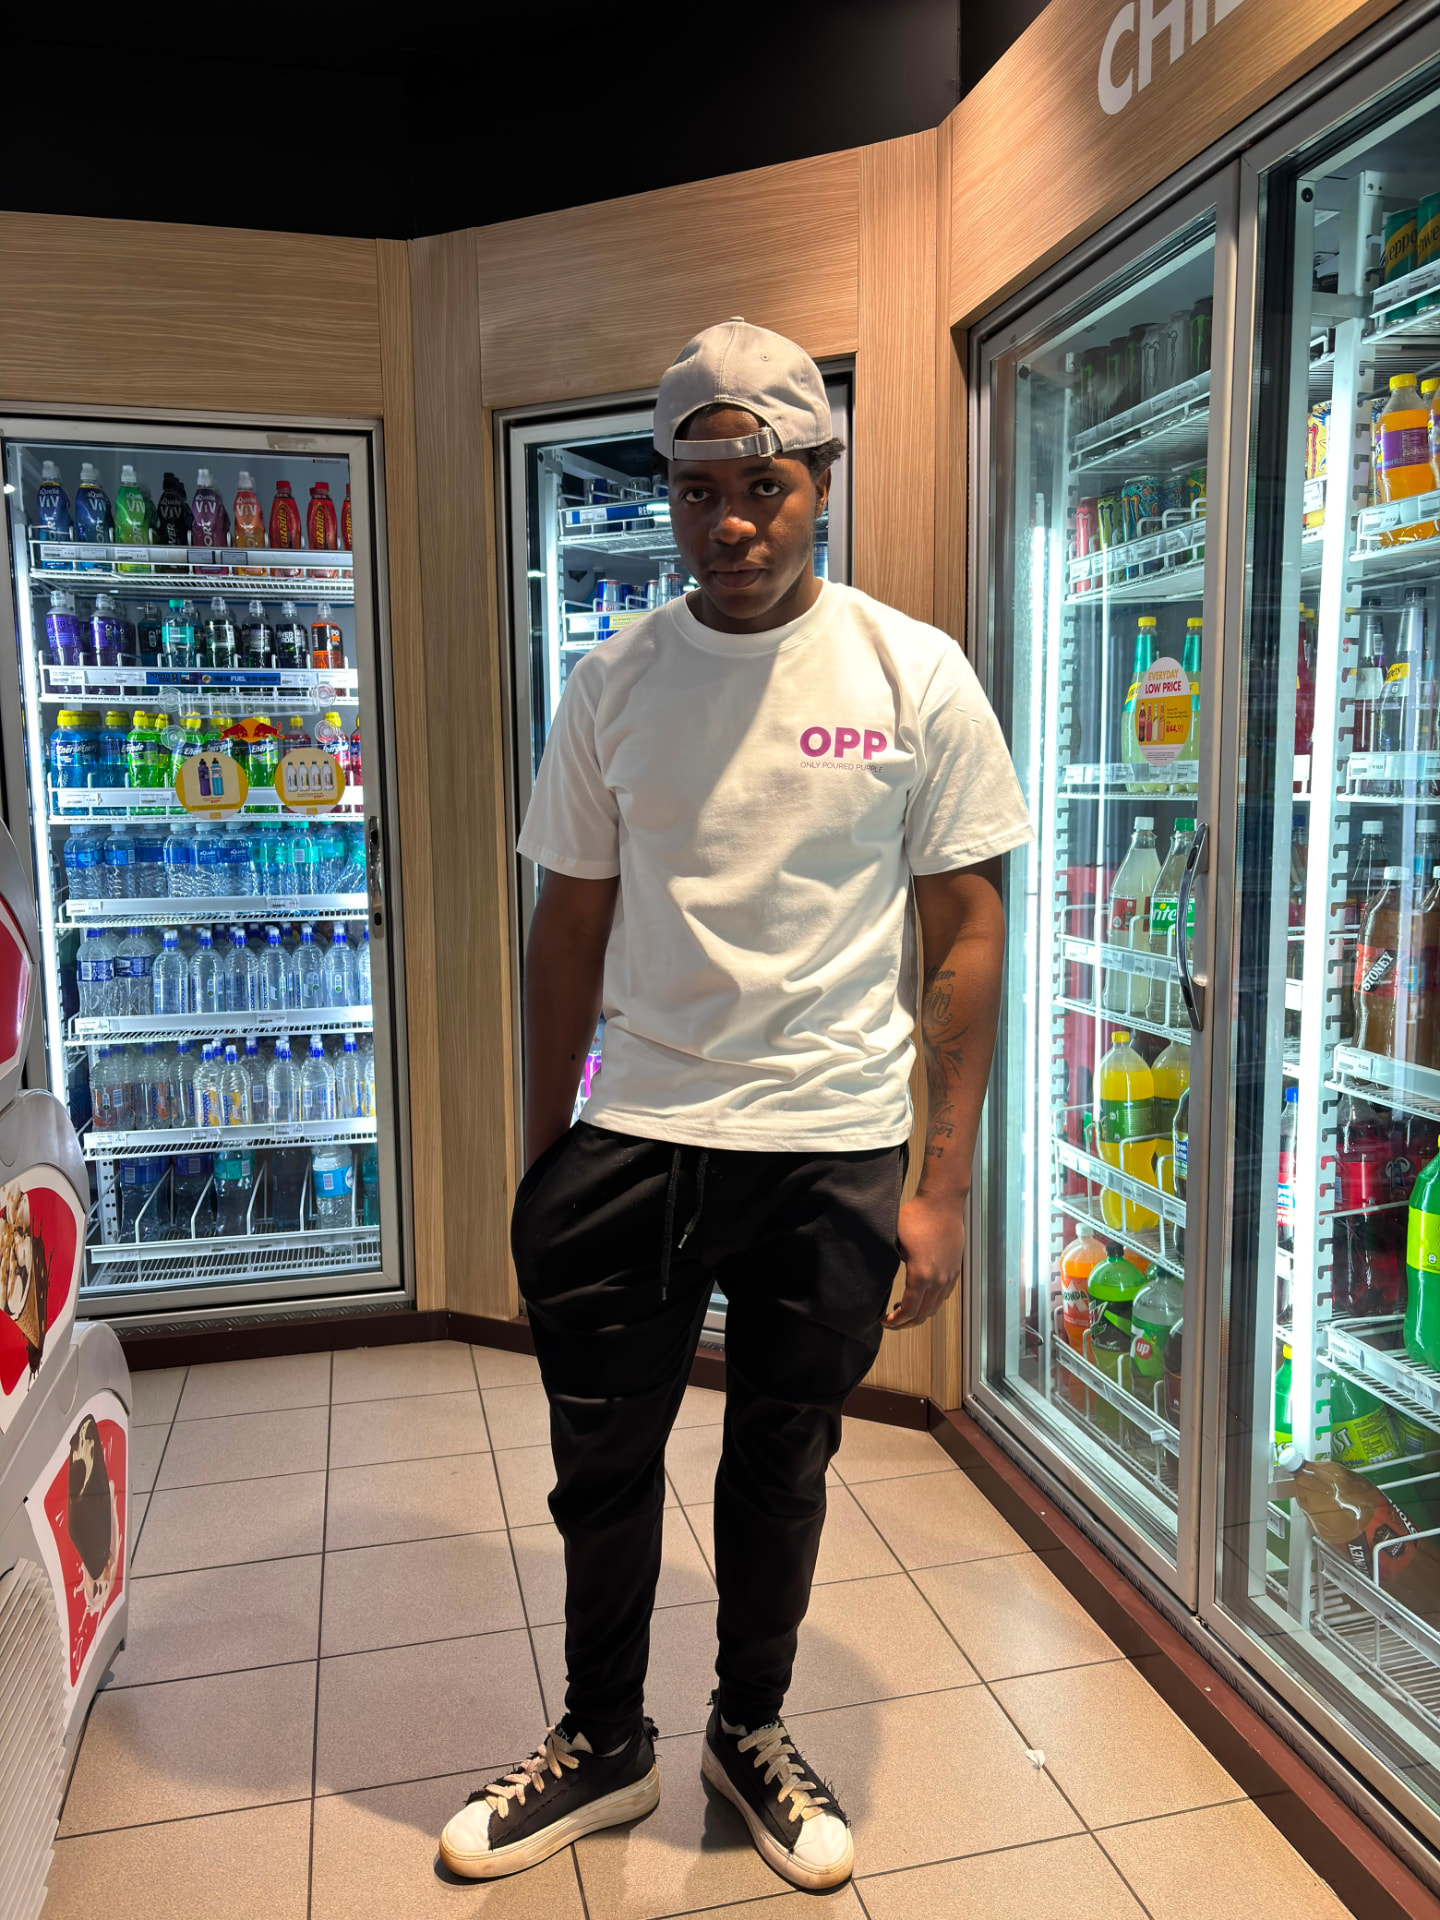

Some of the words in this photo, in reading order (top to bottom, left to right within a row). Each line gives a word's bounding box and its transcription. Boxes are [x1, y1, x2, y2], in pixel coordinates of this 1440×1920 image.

[1148, 669, 1180, 682] EVERYDAY
[1145, 683, 1161, 694] LOW
[1162, 680, 1182, 693] PRICE
[800, 726, 887, 760] OPP
[800, 761, 821, 769] ONLY
[822, 762, 855, 771] POURED
[1361, 951, 1394, 991] STONEY
